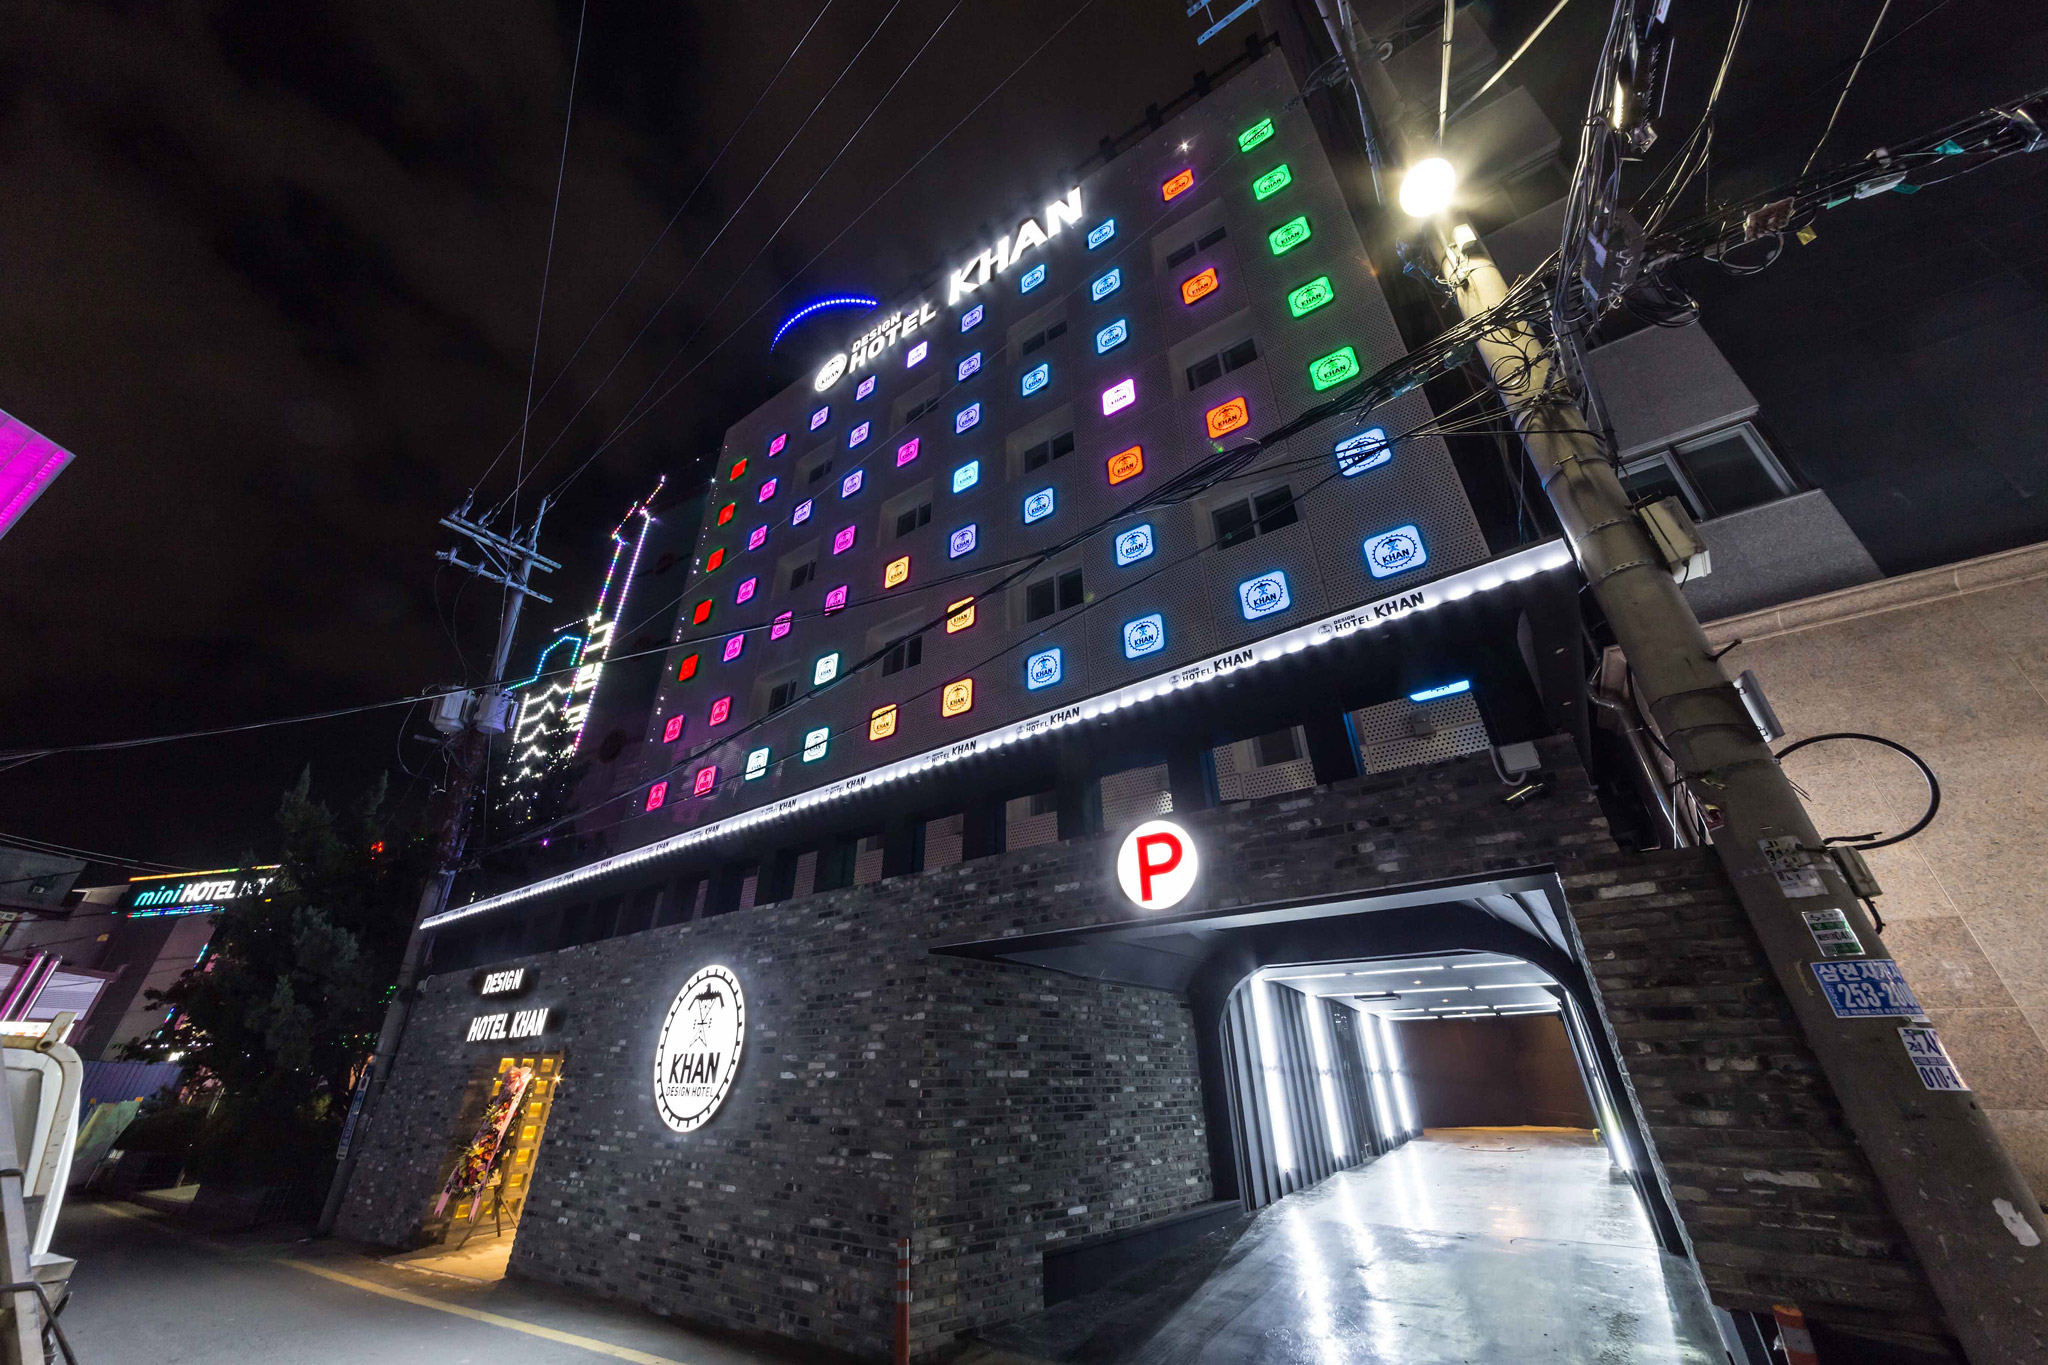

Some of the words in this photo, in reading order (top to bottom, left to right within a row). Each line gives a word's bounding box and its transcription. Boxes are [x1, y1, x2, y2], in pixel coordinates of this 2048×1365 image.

[1280, 230, 1300, 245] KHAN
[849, 303, 937, 373] HOTEL
[949, 186, 1082, 306] KHAN
[1301, 293, 1322, 306] KHAN
[852, 311, 902, 352] DESIGN
[1324, 365, 1347, 379] KHAN
[1217, 415, 1238, 428] KHAN
[1117, 463, 1134, 475] KHAN
[1125, 542, 1144, 555] KHAN
[1382, 548, 1410, 563] KHAN
[1254, 593, 1277, 606] KHAN
[1335, 615, 1373, 632] HOTEL
[1373, 591, 1425, 618] KHAN
[1134, 634, 1154, 647] KHAN
[1035, 667, 1053, 679] KHAN
[1182, 668, 1213, 683] HOTEL
[1213, 649, 1254, 672] KHAN
[949, 697, 965, 707] KHAN
[1050, 707, 1080, 726] KHAN
[951, 740, 977, 756] KHAN
[846, 776, 867, 789] KHAN
[1136, 832, 1183, 902] P
[482, 968, 525, 995] DESIGN
[466, 1012, 508, 1042] HOTEL
[509, 1008, 549, 1039] KHAN
[668, 1052, 721, 1084] KHAN
[666, 1086, 691, 1097] DESIGN
[691, 1086, 714, 1098] HOTEL
